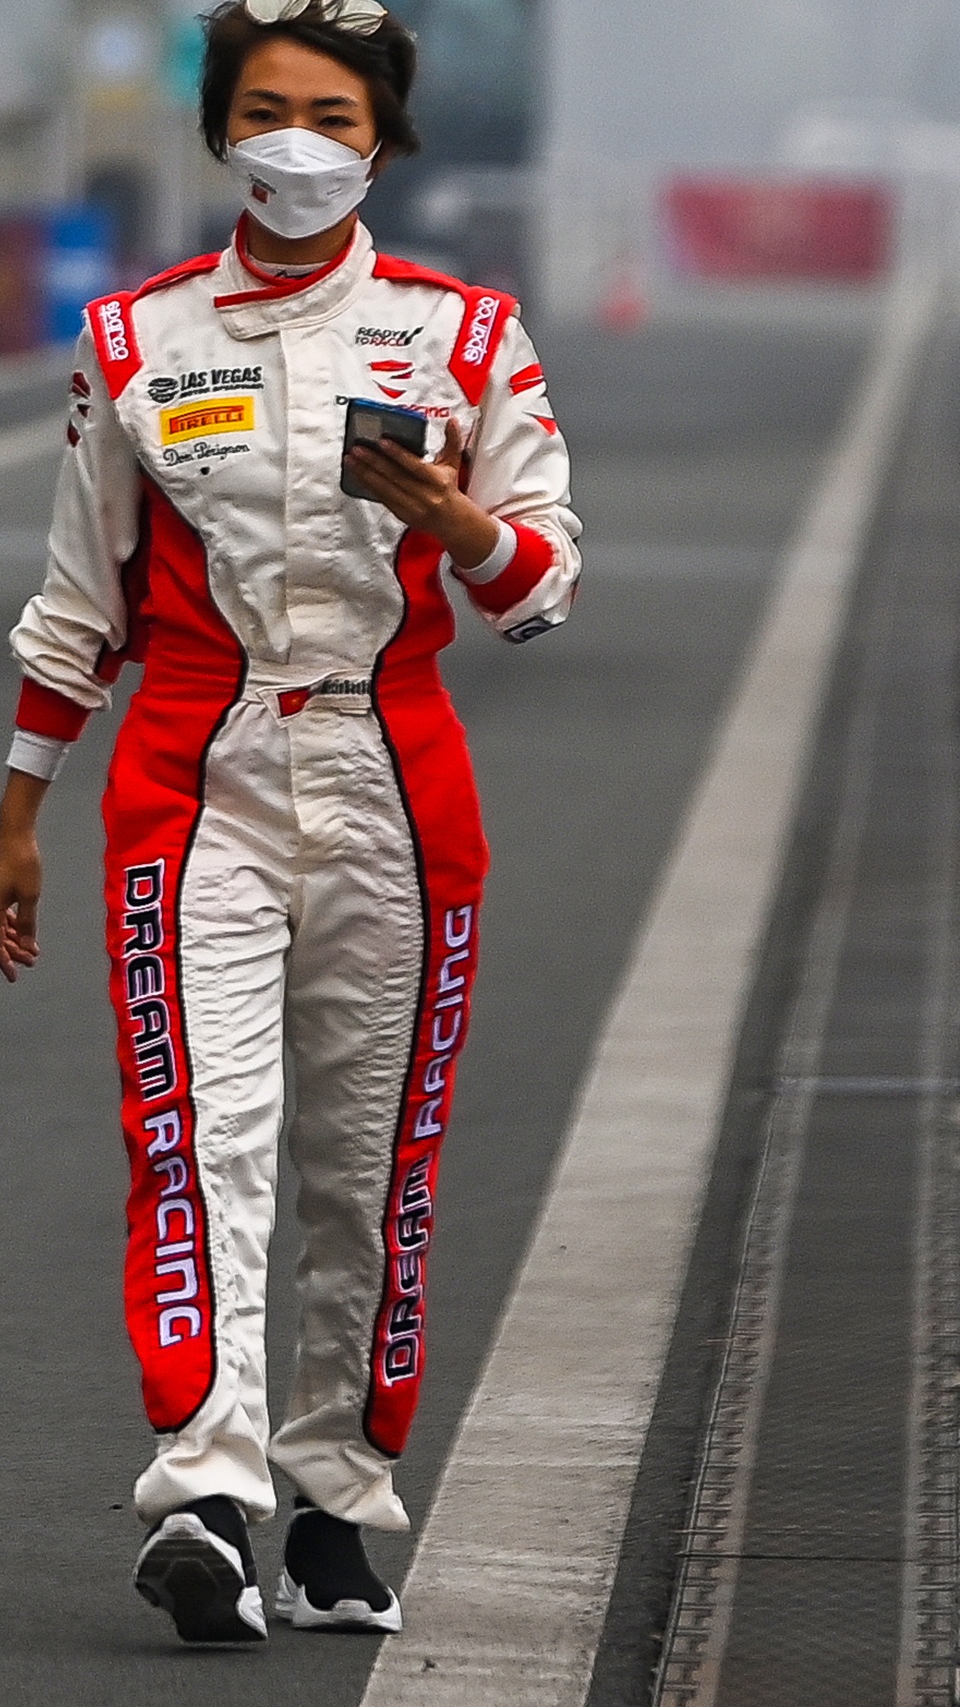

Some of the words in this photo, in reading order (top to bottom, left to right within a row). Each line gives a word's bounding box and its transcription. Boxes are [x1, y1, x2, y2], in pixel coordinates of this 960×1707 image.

[102, 300, 129, 361] sparco
[357, 326, 402, 339] READY
[464, 296, 499, 365] sparco
[180, 372, 208, 391] LAS
[211, 366, 262, 385] VEGAS
[168, 404, 245, 435] PIRELLI
[122, 858, 178, 1102] DREAM
[384, 1153, 433, 1388] DREAM
[415, 904, 472, 1141] RACING
[144, 1108, 202, 1348] RACING
